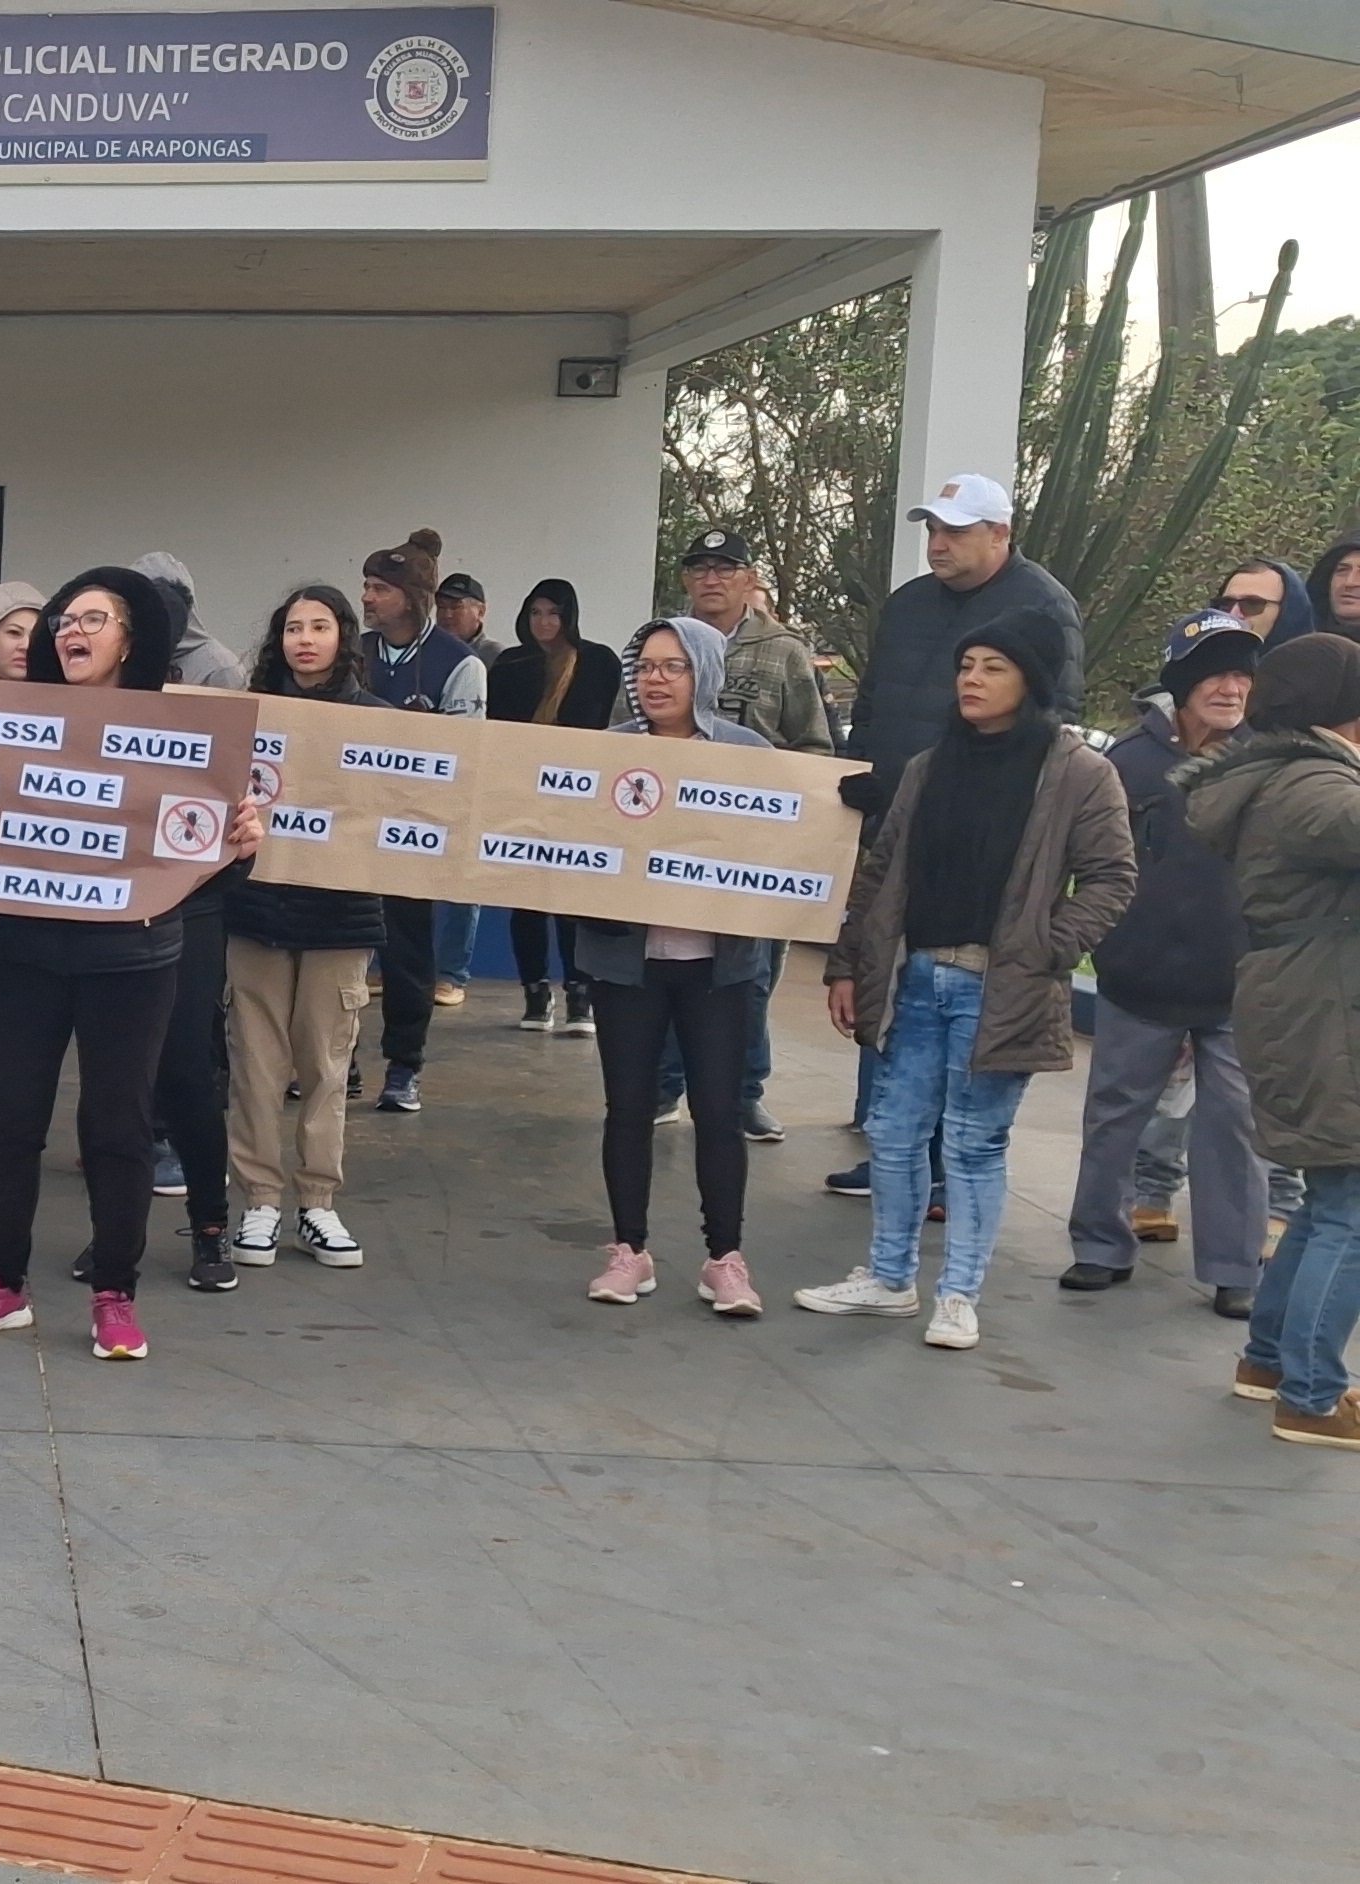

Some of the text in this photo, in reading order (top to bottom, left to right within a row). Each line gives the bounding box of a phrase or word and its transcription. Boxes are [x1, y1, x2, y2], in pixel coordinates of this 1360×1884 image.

[126, 41, 349, 74] INTEGRADO
[371, 39, 465, 75] PATRULHEIRO
[373, 110, 419, 138] PROTETOR
[421, 129, 429, 137] E
[430, 109, 458, 135] AMIGO
[94, 140, 122, 158] DE
[126, 138, 252, 158] ARAPONGAS
[103, 732, 208, 763] SAÚDE
[22, 771, 116, 802] NÃO É
[343, 749, 426, 774] SAÚDE
[434, 759, 450, 776] E
[540, 770, 592, 792] NÃO
[678, 786, 782, 815] MOSCAS
[791, 799, 799, 816] !
[0, 818, 122, 854] LIXO DE
[271, 811, 823, 897] NÃO SÃO VIZINHAS BEM-VINDAS!
[114, 886, 123, 905] !
